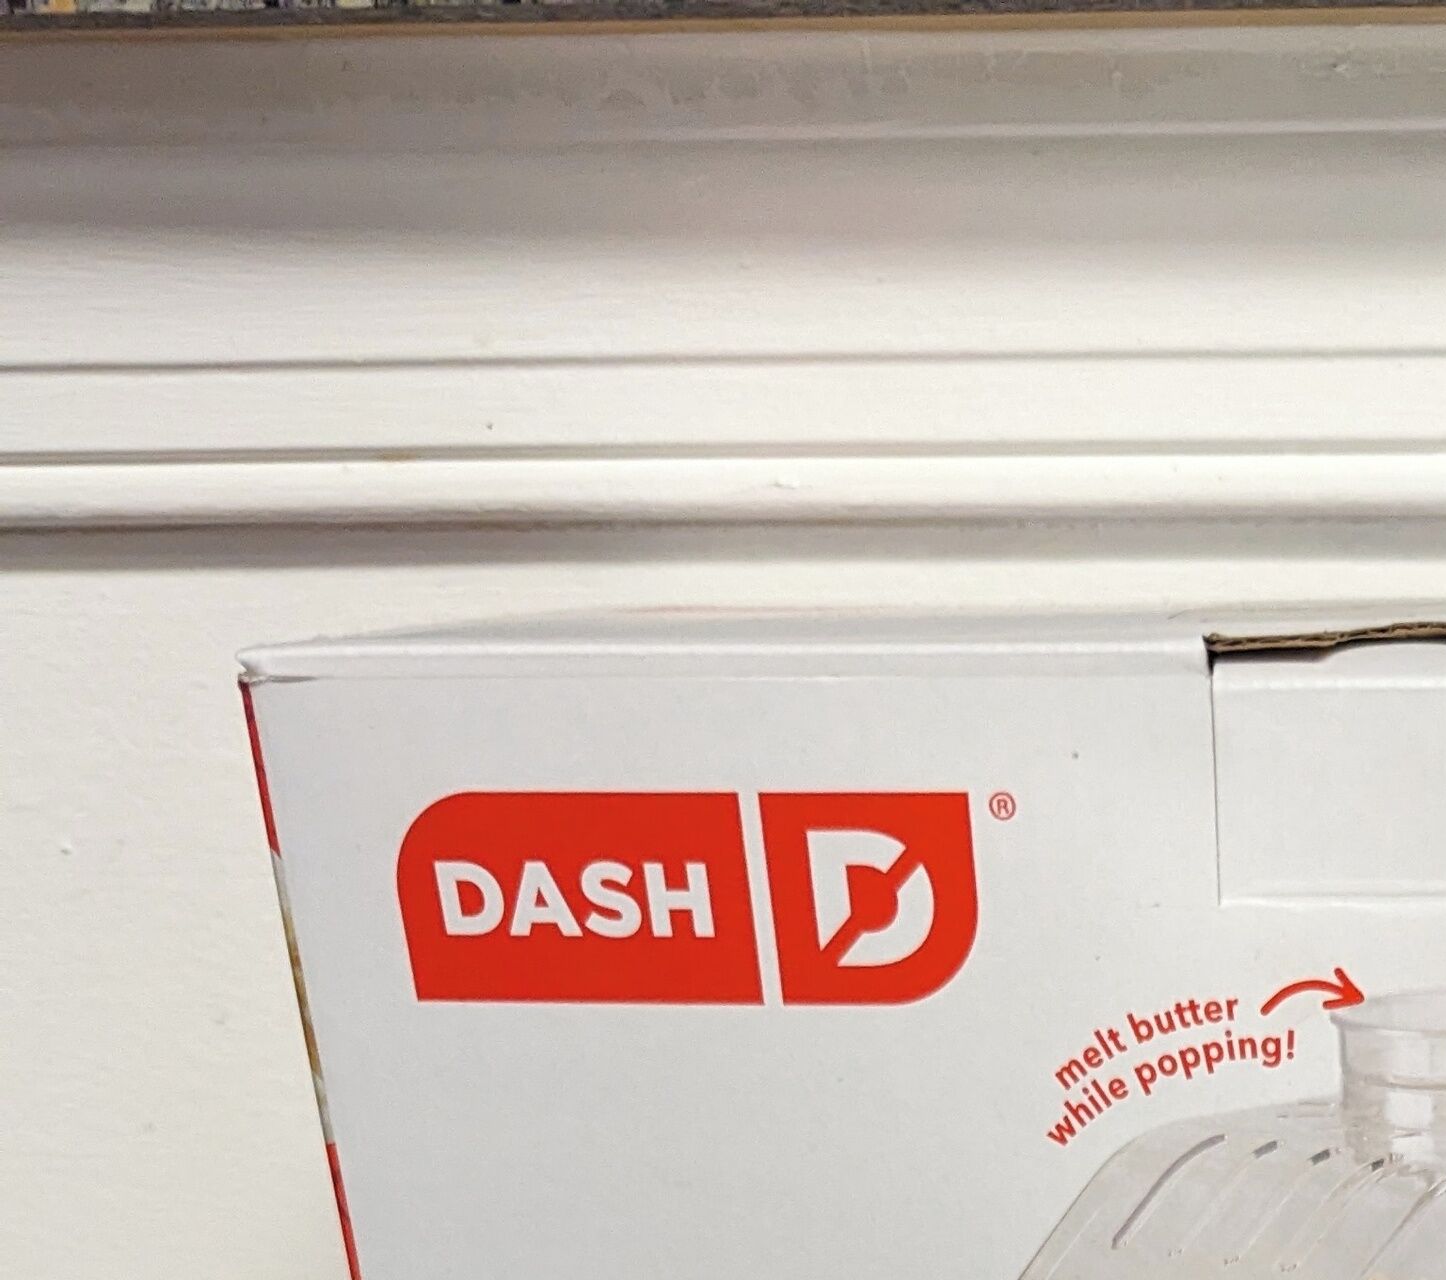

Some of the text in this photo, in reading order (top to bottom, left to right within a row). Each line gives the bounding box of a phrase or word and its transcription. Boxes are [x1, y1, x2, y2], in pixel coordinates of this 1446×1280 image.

[433, 861, 716, 937] DASH
[1046, 1029, 1295, 1146] while popping!
[1055, 998, 1238, 1090] melt butter
